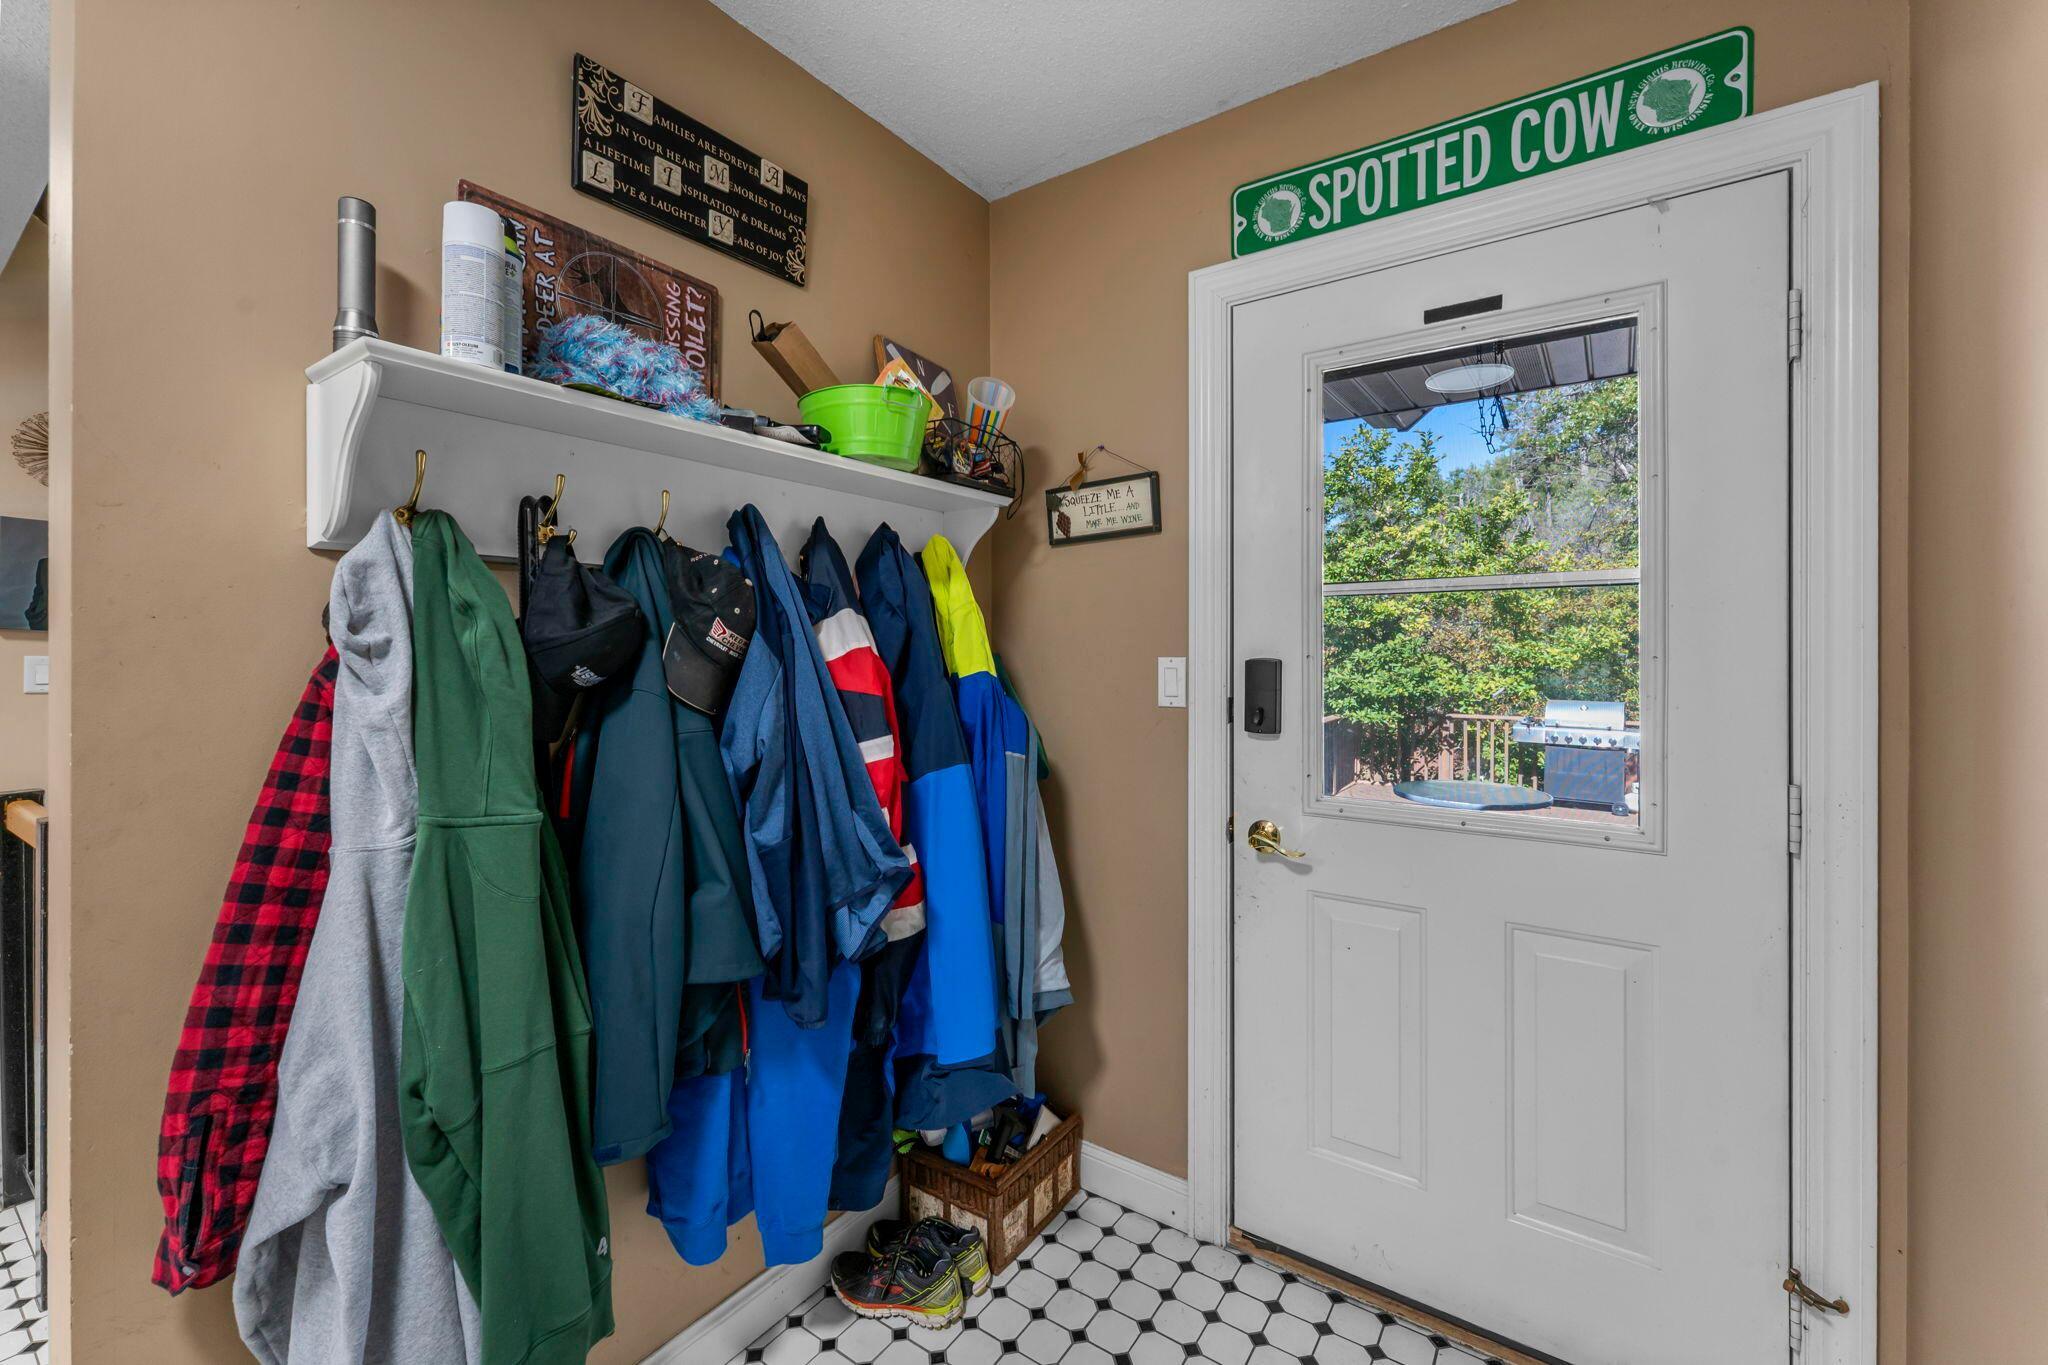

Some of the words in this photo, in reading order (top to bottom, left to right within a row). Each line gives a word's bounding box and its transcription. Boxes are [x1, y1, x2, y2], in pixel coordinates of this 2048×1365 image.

[630, 91, 696, 143] FAMILIES
[697, 138, 718, 155] ARE
[719, 149, 761, 179] FOREVER
[765, 166, 807, 204] AWAYS
[1629, 114, 1646, 132] ONLY
[1647, 127, 1660, 135] IN
[1663, 93, 1714, 134] WISCONSIN
[583, 137, 593, 149] A
[596, 141, 653, 177] LIFETIME
[663, 165, 741, 219] INSPIRATION
[741, 213, 750, 224] &
[750, 217, 788, 241] DREAMS
[616, 122, 630, 138] IN
[631, 131, 664, 156] YOUR
[666, 148, 702, 174] HEART
[709, 163, 769, 208] MEMORIES
[769, 201, 783, 215] TO
[783, 209, 804, 226] LAST
[1307, 125, 1491, 231] SPOTTED
[1511, 79, 1625, 173] COW
[534, 228, 556, 267] AT
[589, 160, 637, 198] LOVE
[638, 191, 648, 204] &
[650, 195, 708, 230] LAUGHTER
[756, 244, 769, 257] OF
[768, 250, 785, 264] JOY
[535, 271, 556, 333] DEER
[665, 281, 682, 347] ISSING
[684, 286, 706, 370] OILET?
[1064, 492, 1102, 508] SQUEEZE
[1106, 488, 1122, 501] ME
[1126, 485, 1135, 498] A
[1106, 516, 1118, 526] ME
[1120, 513, 1143, 524] WINE
